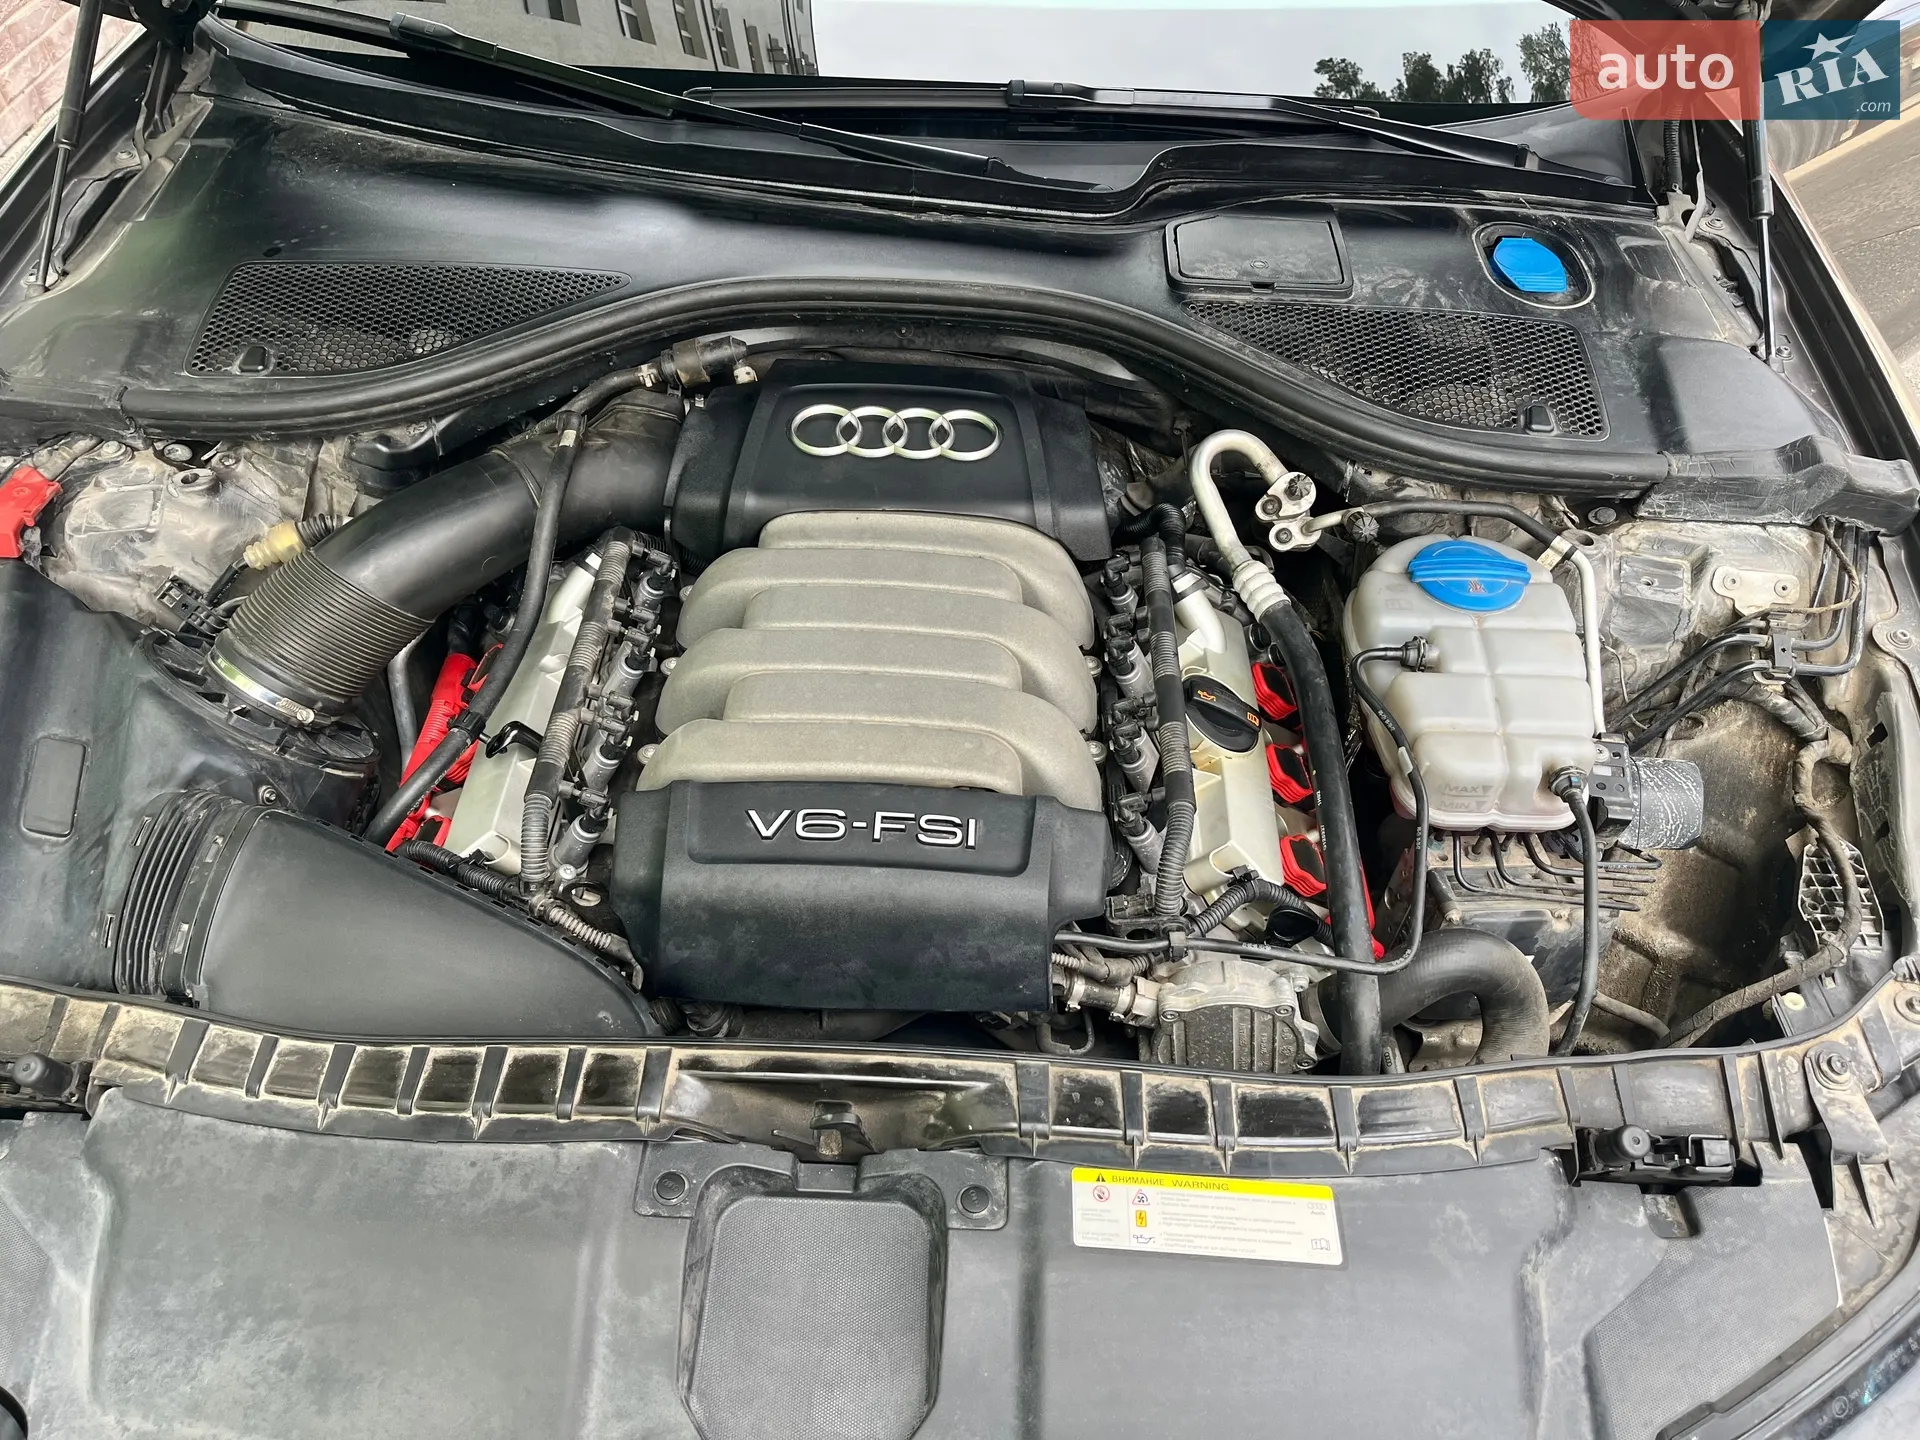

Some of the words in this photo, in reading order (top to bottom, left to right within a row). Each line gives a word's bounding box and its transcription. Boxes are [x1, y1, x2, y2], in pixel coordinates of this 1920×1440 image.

[1444, 783, 1480, 794] MAX
[1441, 800, 1471, 809] MIN
[745, 808, 978, 850] V6-FSI
[1111, 1175, 1165, 1186] ВНИМАНИЕ
[1171, 1179, 1230, 1191] WARNING
